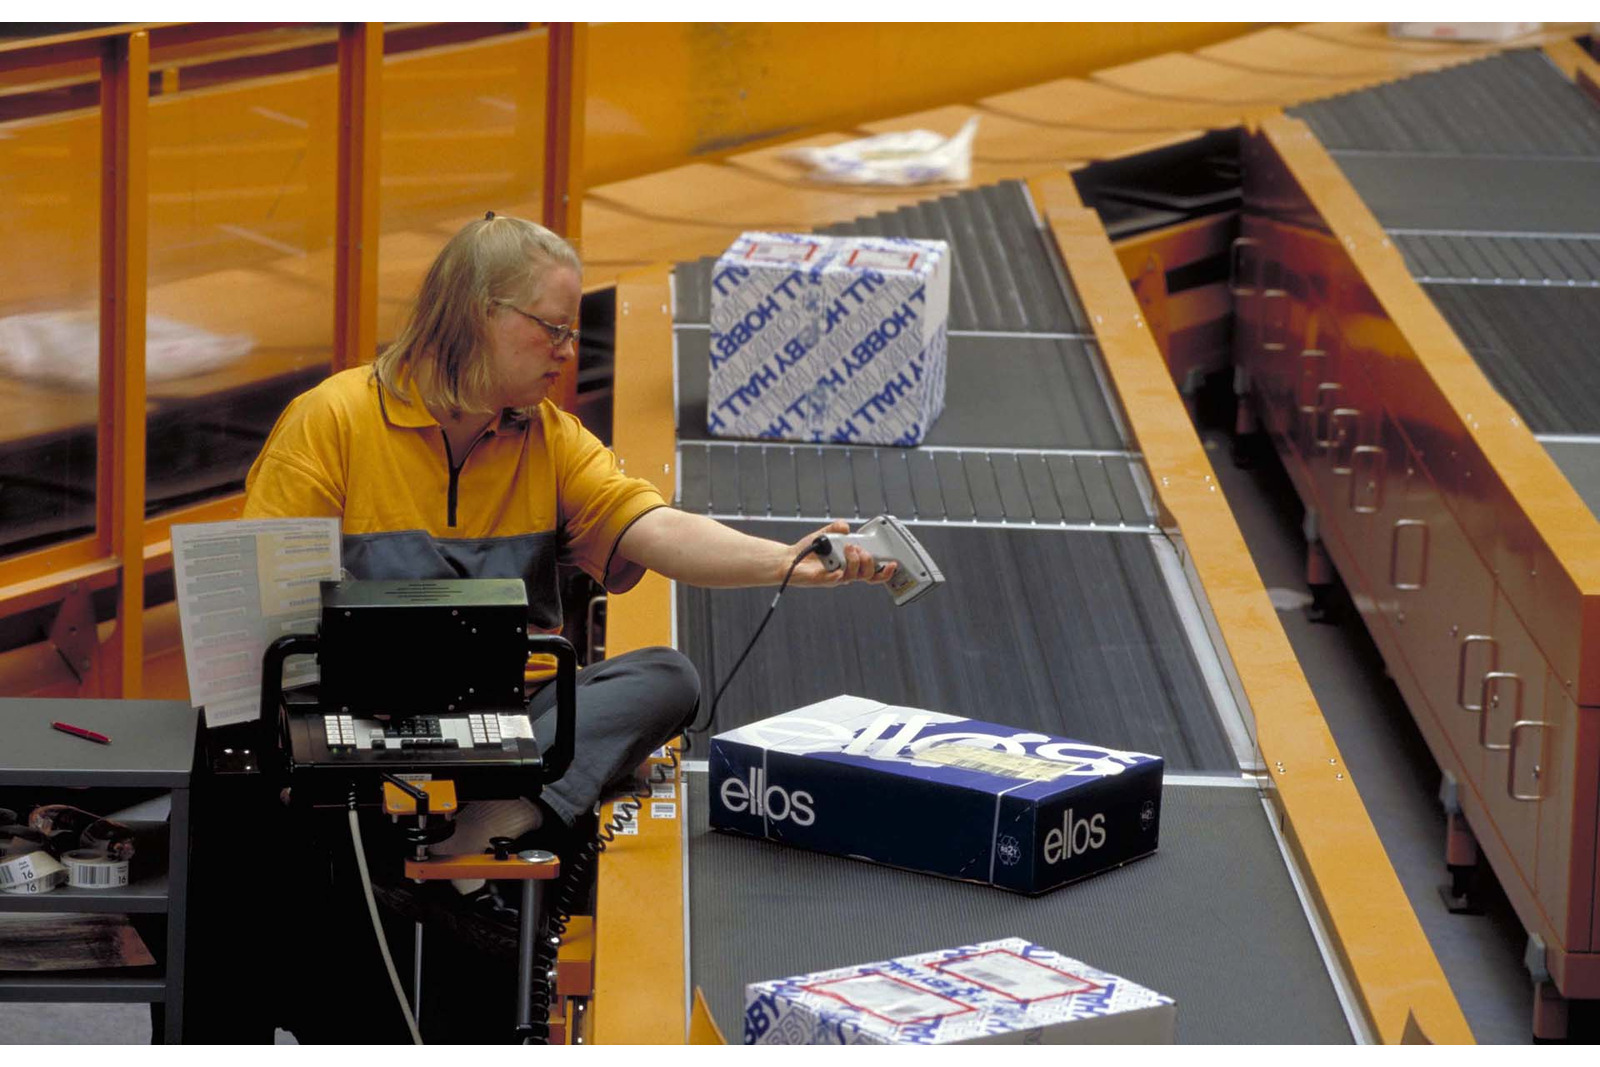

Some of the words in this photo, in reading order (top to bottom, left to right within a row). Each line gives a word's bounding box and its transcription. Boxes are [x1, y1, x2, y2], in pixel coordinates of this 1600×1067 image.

[841, 301, 917, 378] HOBBY
[718, 363, 778, 416] HALL
[852, 371, 914, 424] HALL
[720, 766, 816, 826] ellos
[1043, 808, 1107, 865] ellos
[22, 870, 34, 880] 16
[26, 883, 37, 892] 16
[118, 876, 127, 884] 16
